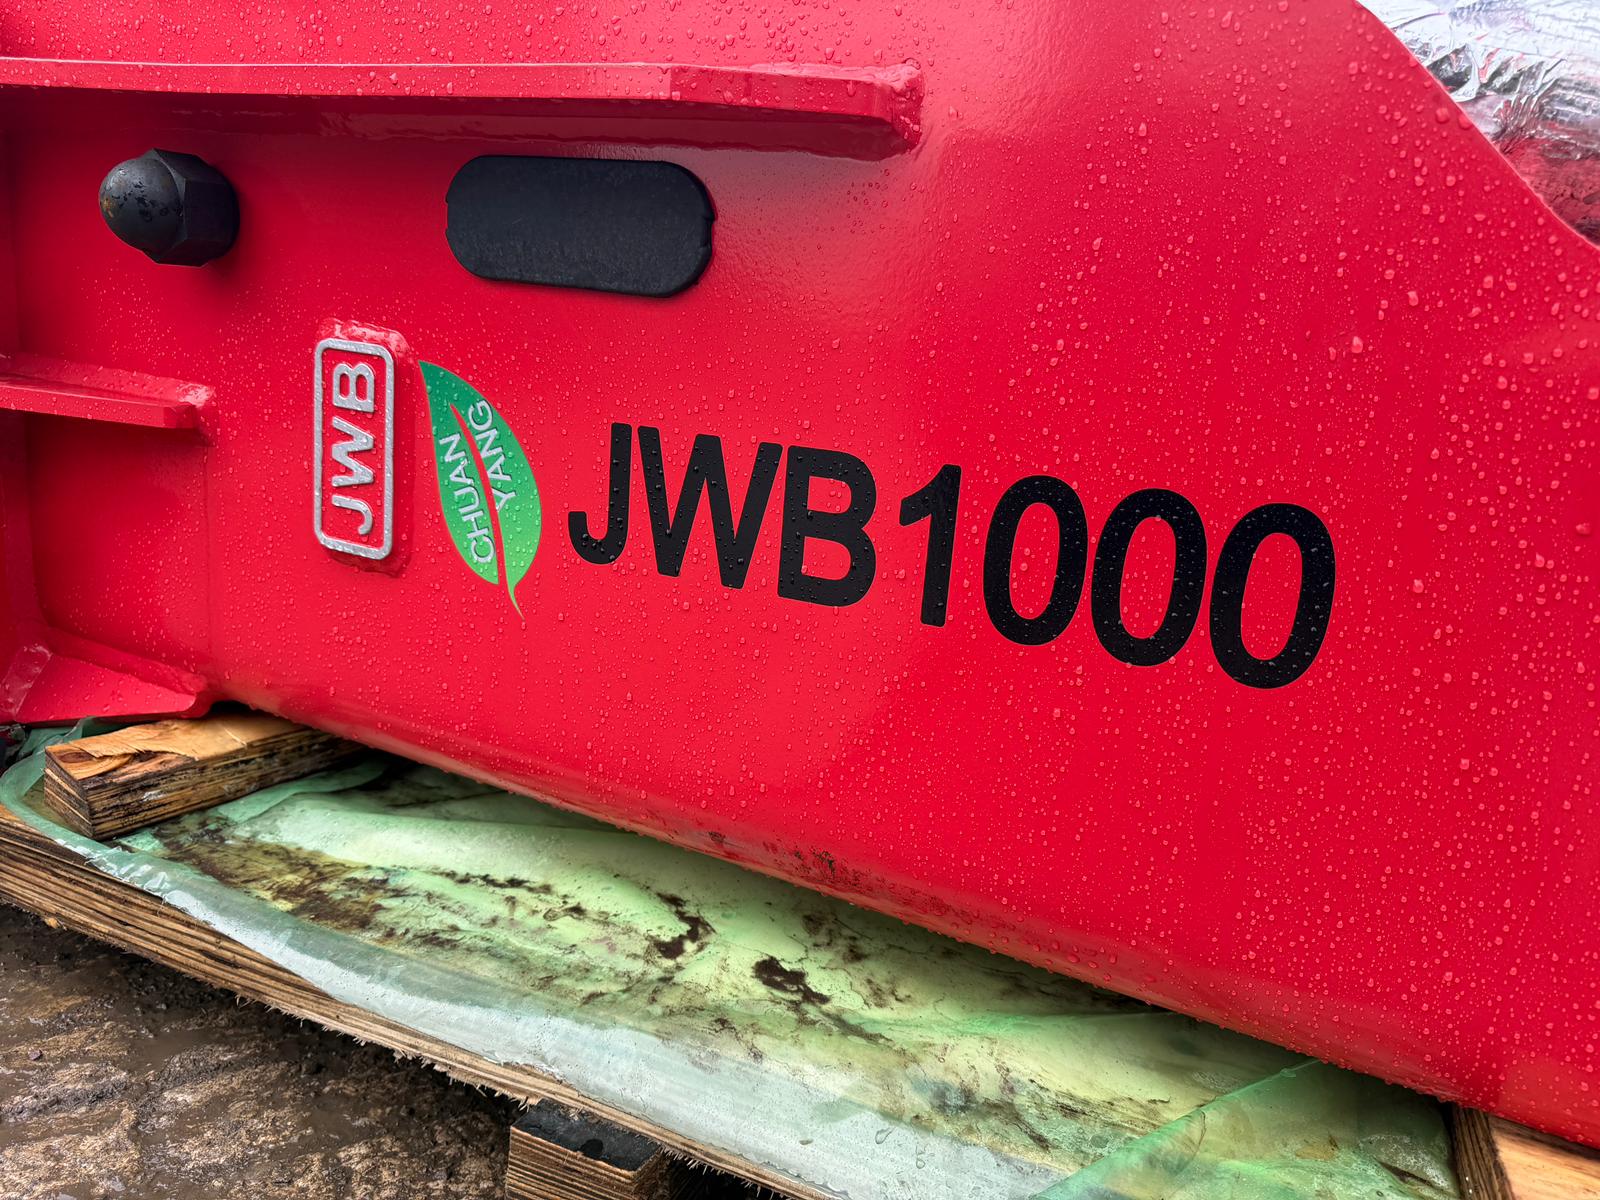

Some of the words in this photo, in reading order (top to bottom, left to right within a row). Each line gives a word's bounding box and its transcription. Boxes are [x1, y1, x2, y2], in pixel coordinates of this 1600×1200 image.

[332, 362, 375, 535] JWB
[438, 433, 496, 564] CHUAN
[467, 399, 516, 513] YANG
[567, 422, 1336, 688] JWB1000
